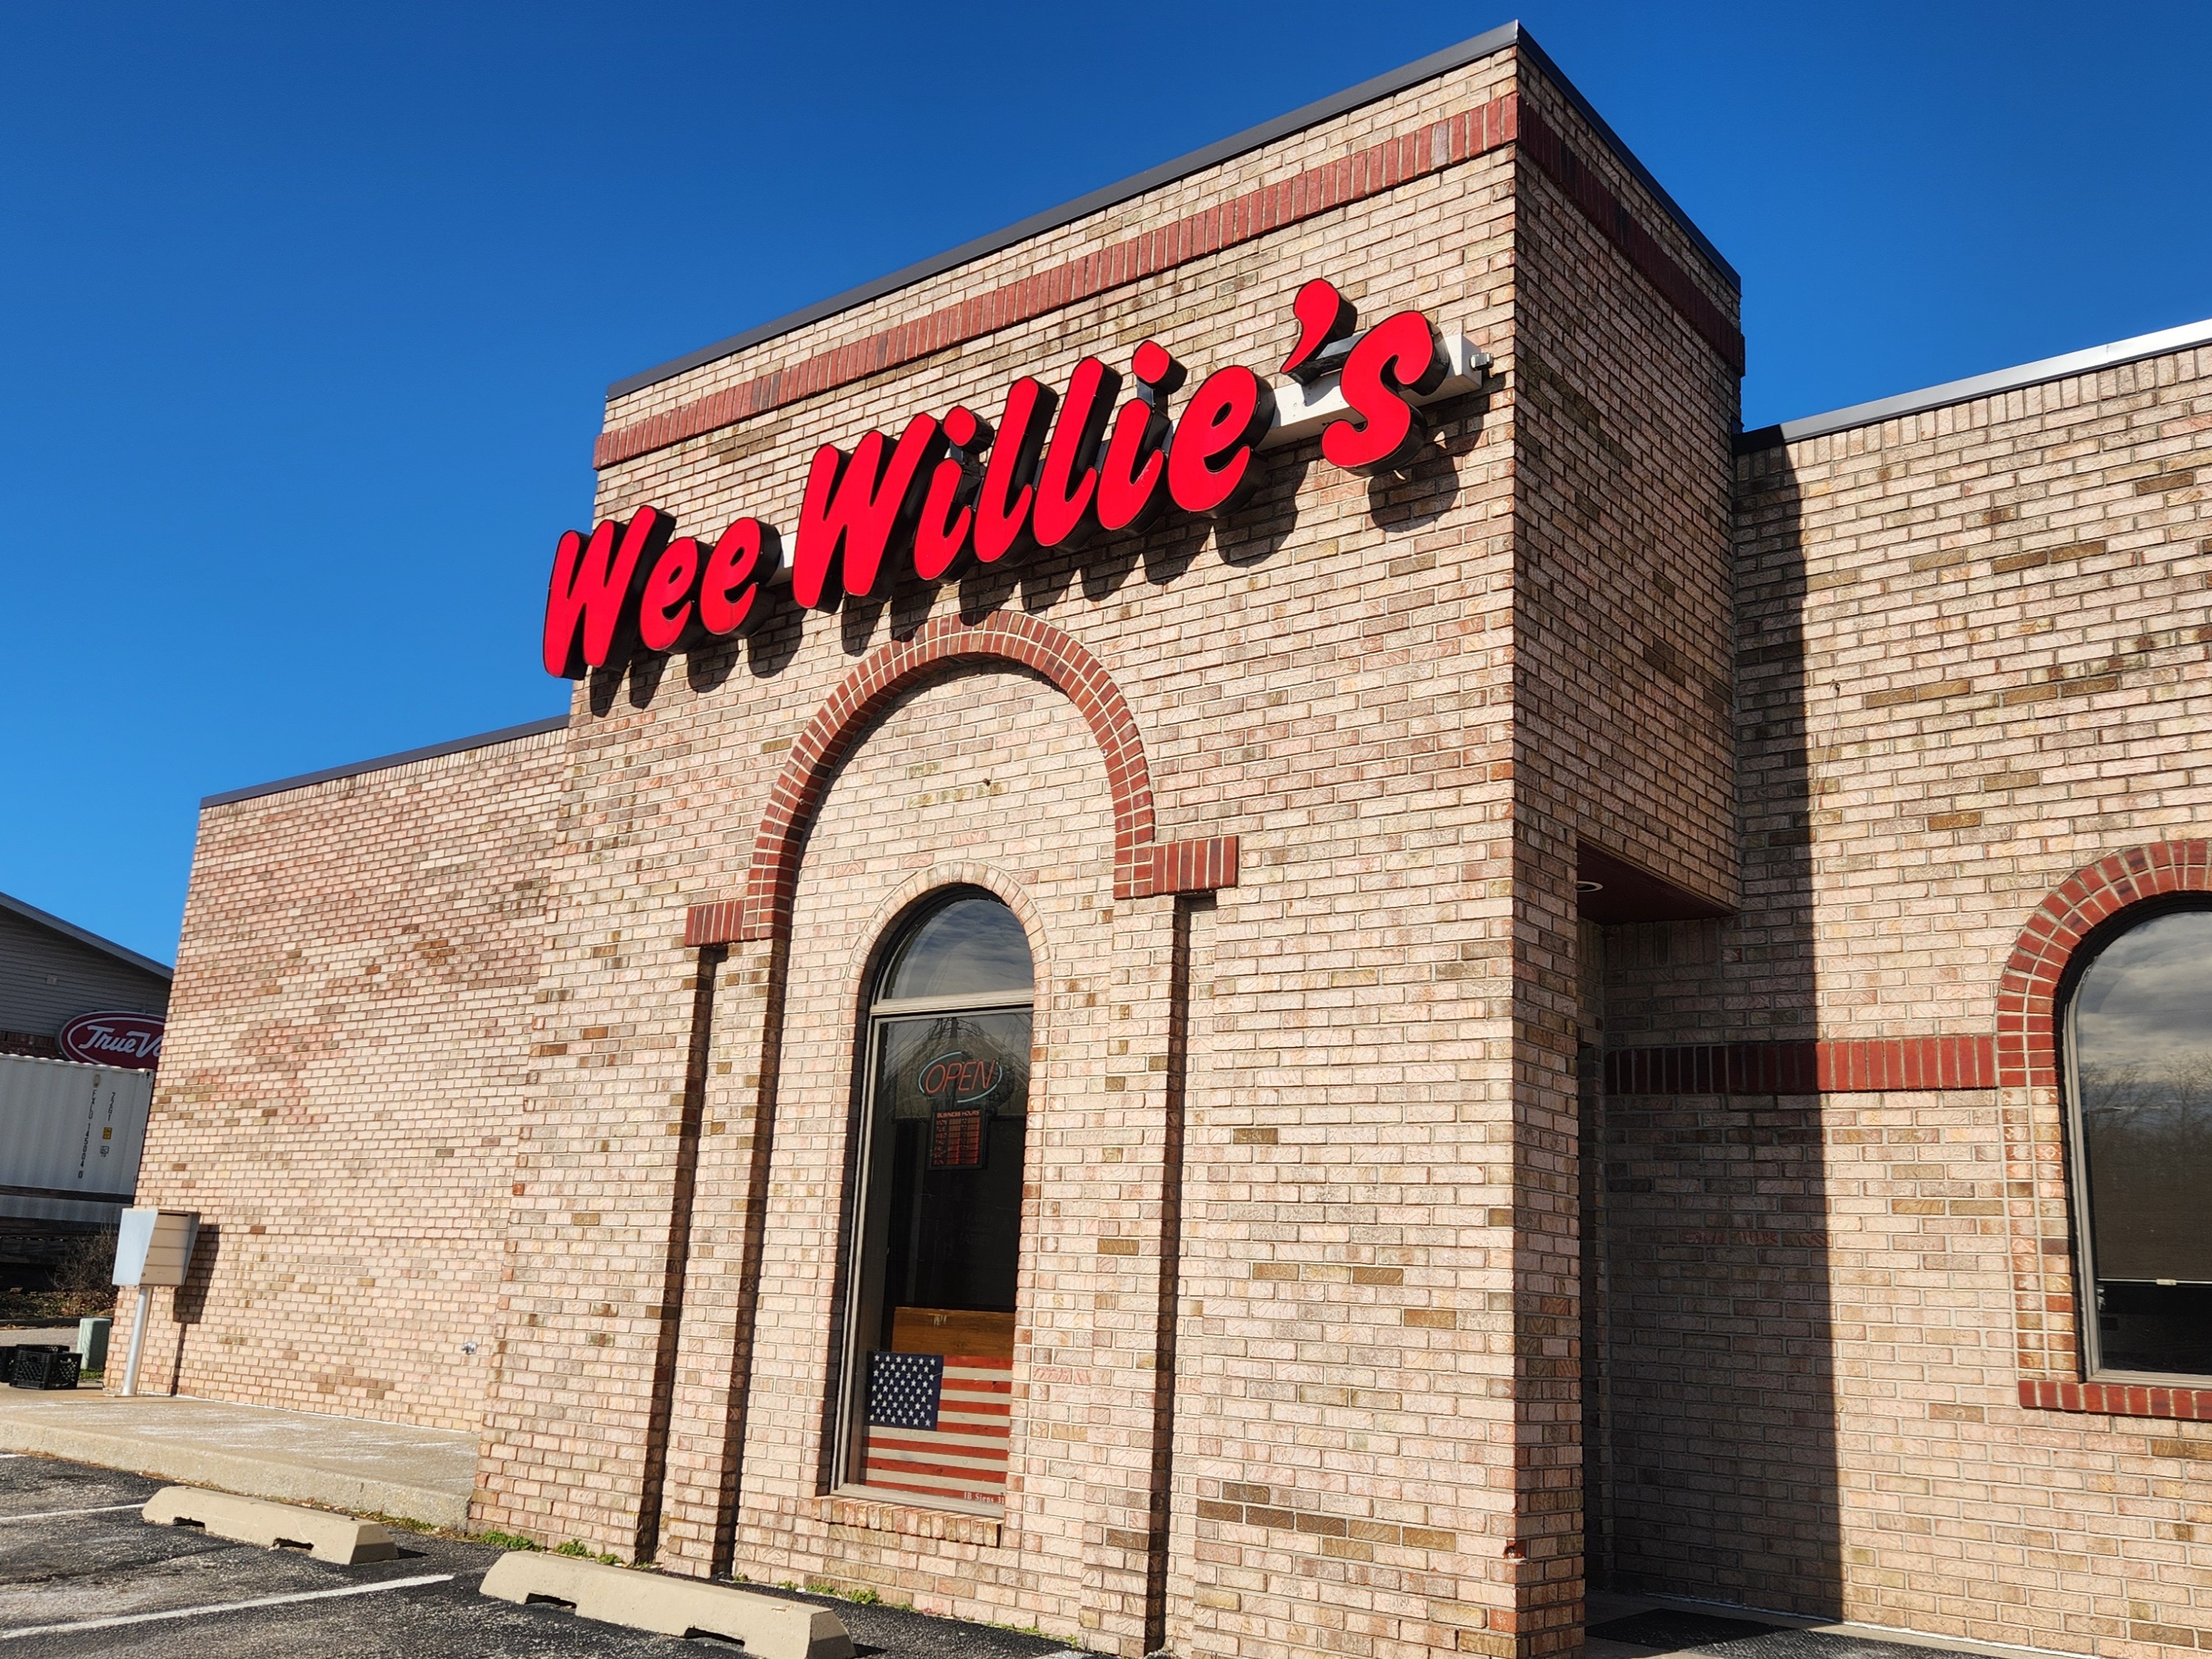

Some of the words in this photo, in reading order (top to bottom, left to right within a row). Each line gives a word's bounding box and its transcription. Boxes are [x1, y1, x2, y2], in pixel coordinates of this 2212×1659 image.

[543, 504, 762, 678] Wee
[792, 278, 1435, 611] Willie's
[925, 1059, 996, 1094] OPEN
